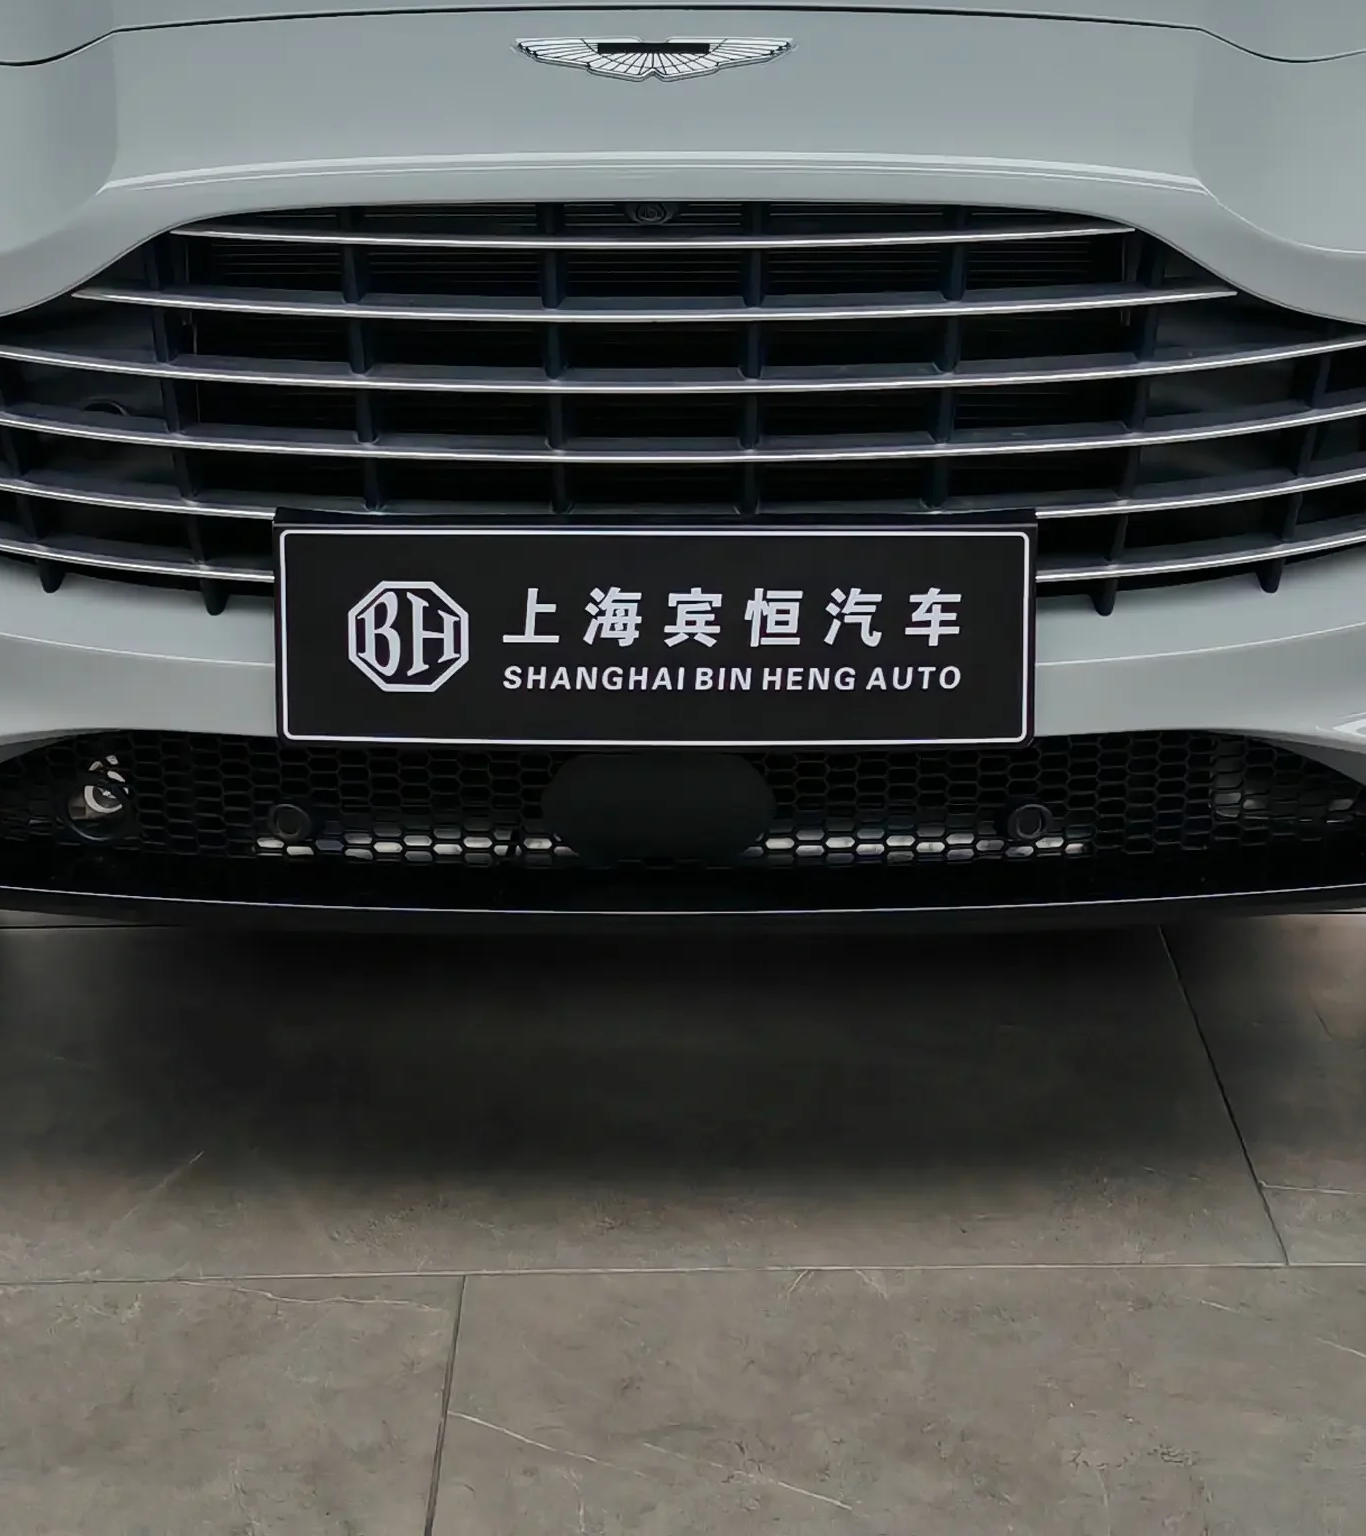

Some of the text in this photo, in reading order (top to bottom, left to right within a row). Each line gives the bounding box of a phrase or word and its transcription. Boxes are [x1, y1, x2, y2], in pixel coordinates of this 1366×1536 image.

[357, 591, 461, 677] BH
[502, 586, 962, 648] 上海宾恒汽车
[502, 665, 961, 691] SHANGHAI BIN HENG AUTO
